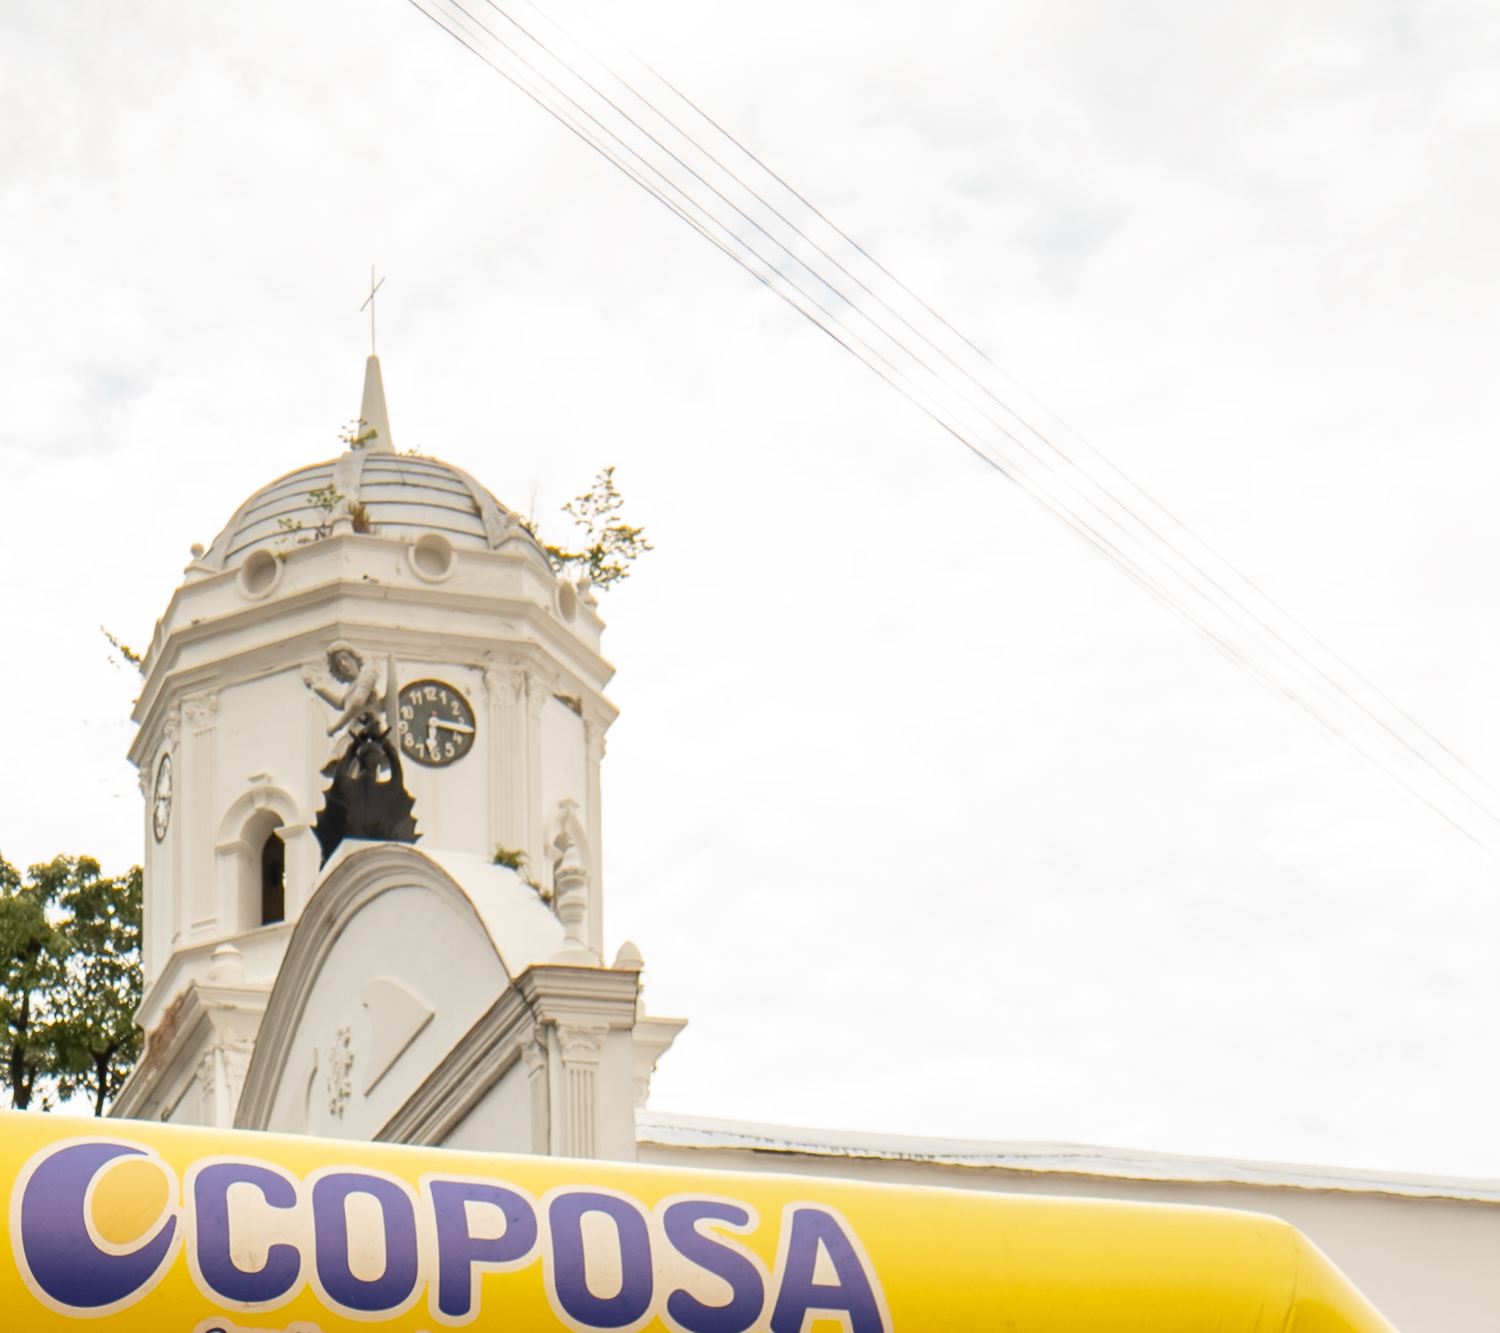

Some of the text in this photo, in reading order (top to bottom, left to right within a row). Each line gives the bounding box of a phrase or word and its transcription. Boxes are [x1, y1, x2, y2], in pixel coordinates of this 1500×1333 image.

[409, 690, 423, 705] 11
[423, 686, 437, 701] 12
[439, 690, 447, 705] 1
[400, 705, 414, 720] 10
[451, 701, 460, 716] 2
[404, 732, 414, 747] 8
[415, 743, 424, 759] 7
[445, 742, 455, 758] 5
